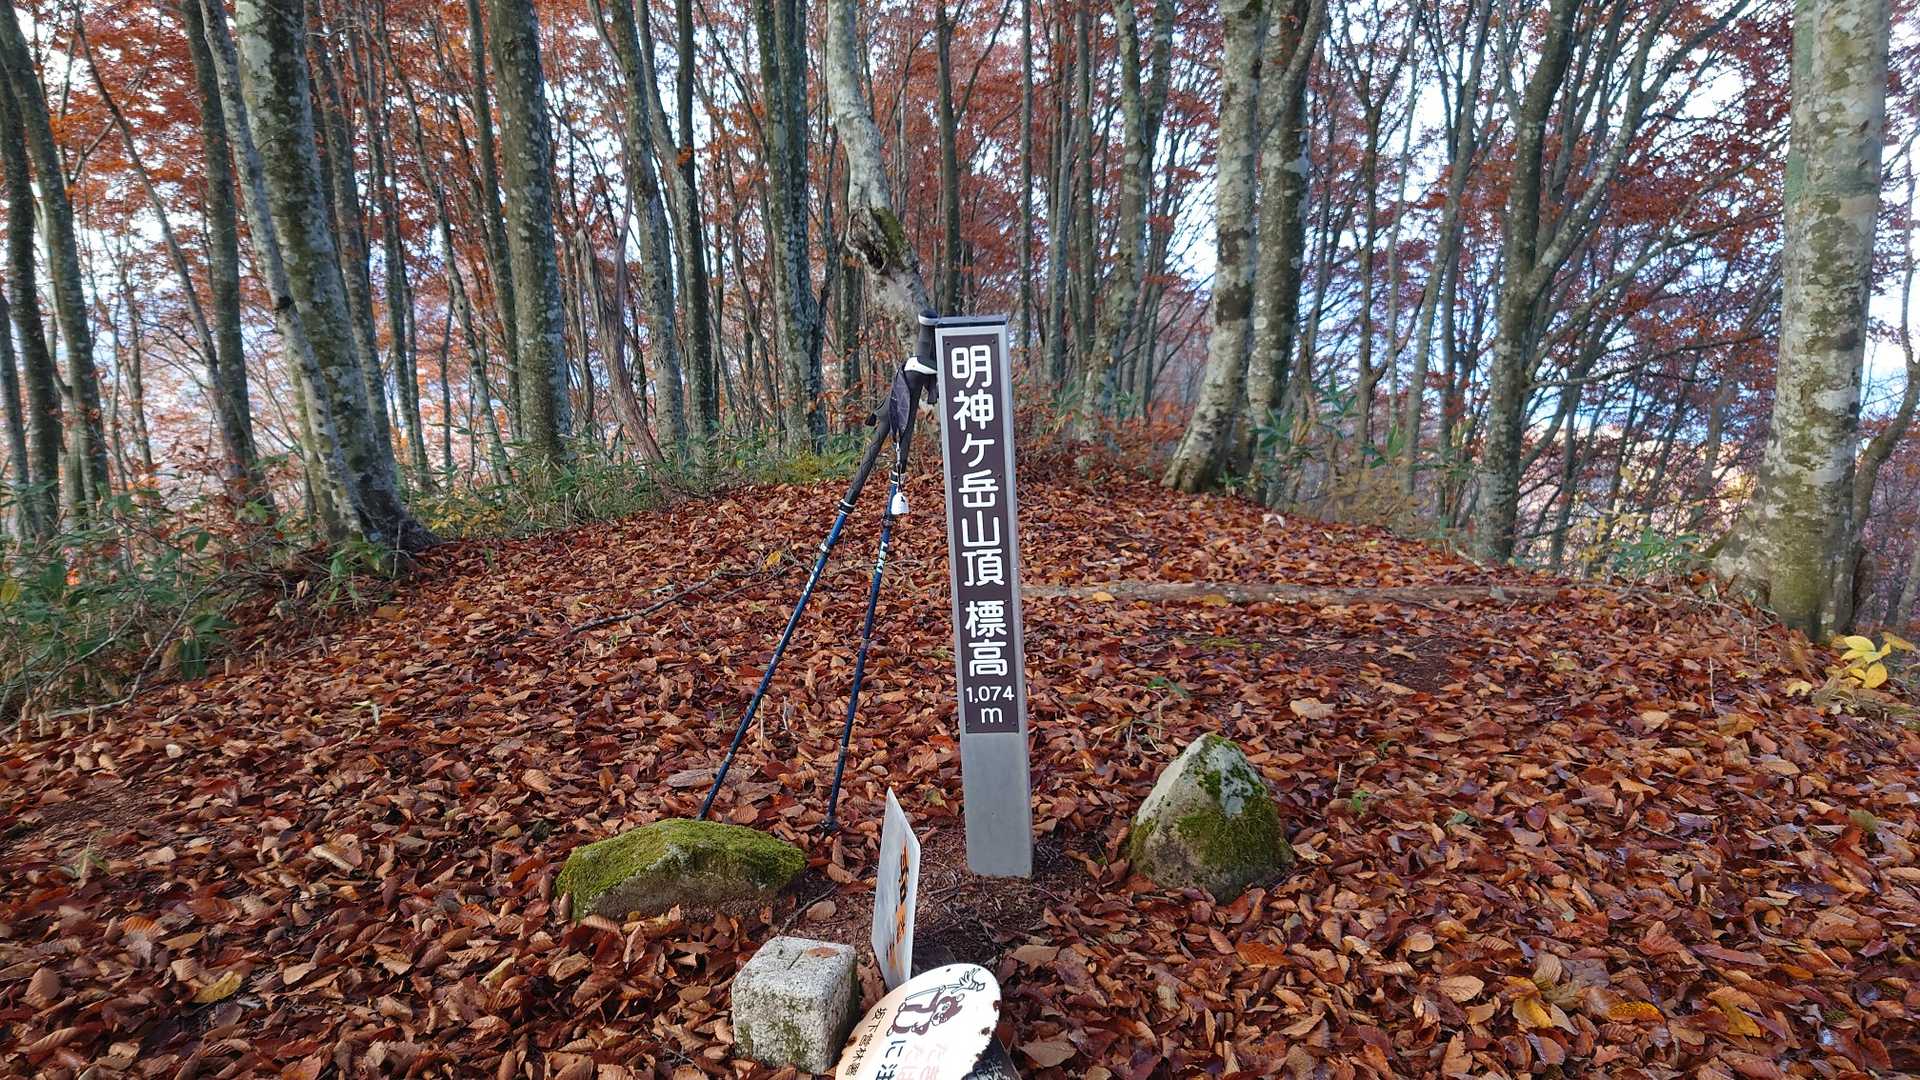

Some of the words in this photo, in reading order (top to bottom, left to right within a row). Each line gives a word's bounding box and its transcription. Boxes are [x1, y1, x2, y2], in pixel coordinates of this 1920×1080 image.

[965, 600, 1008, 677] 標高
[966, 685, 1015, 704] 1,074
[980, 707, 1003, 724] m
